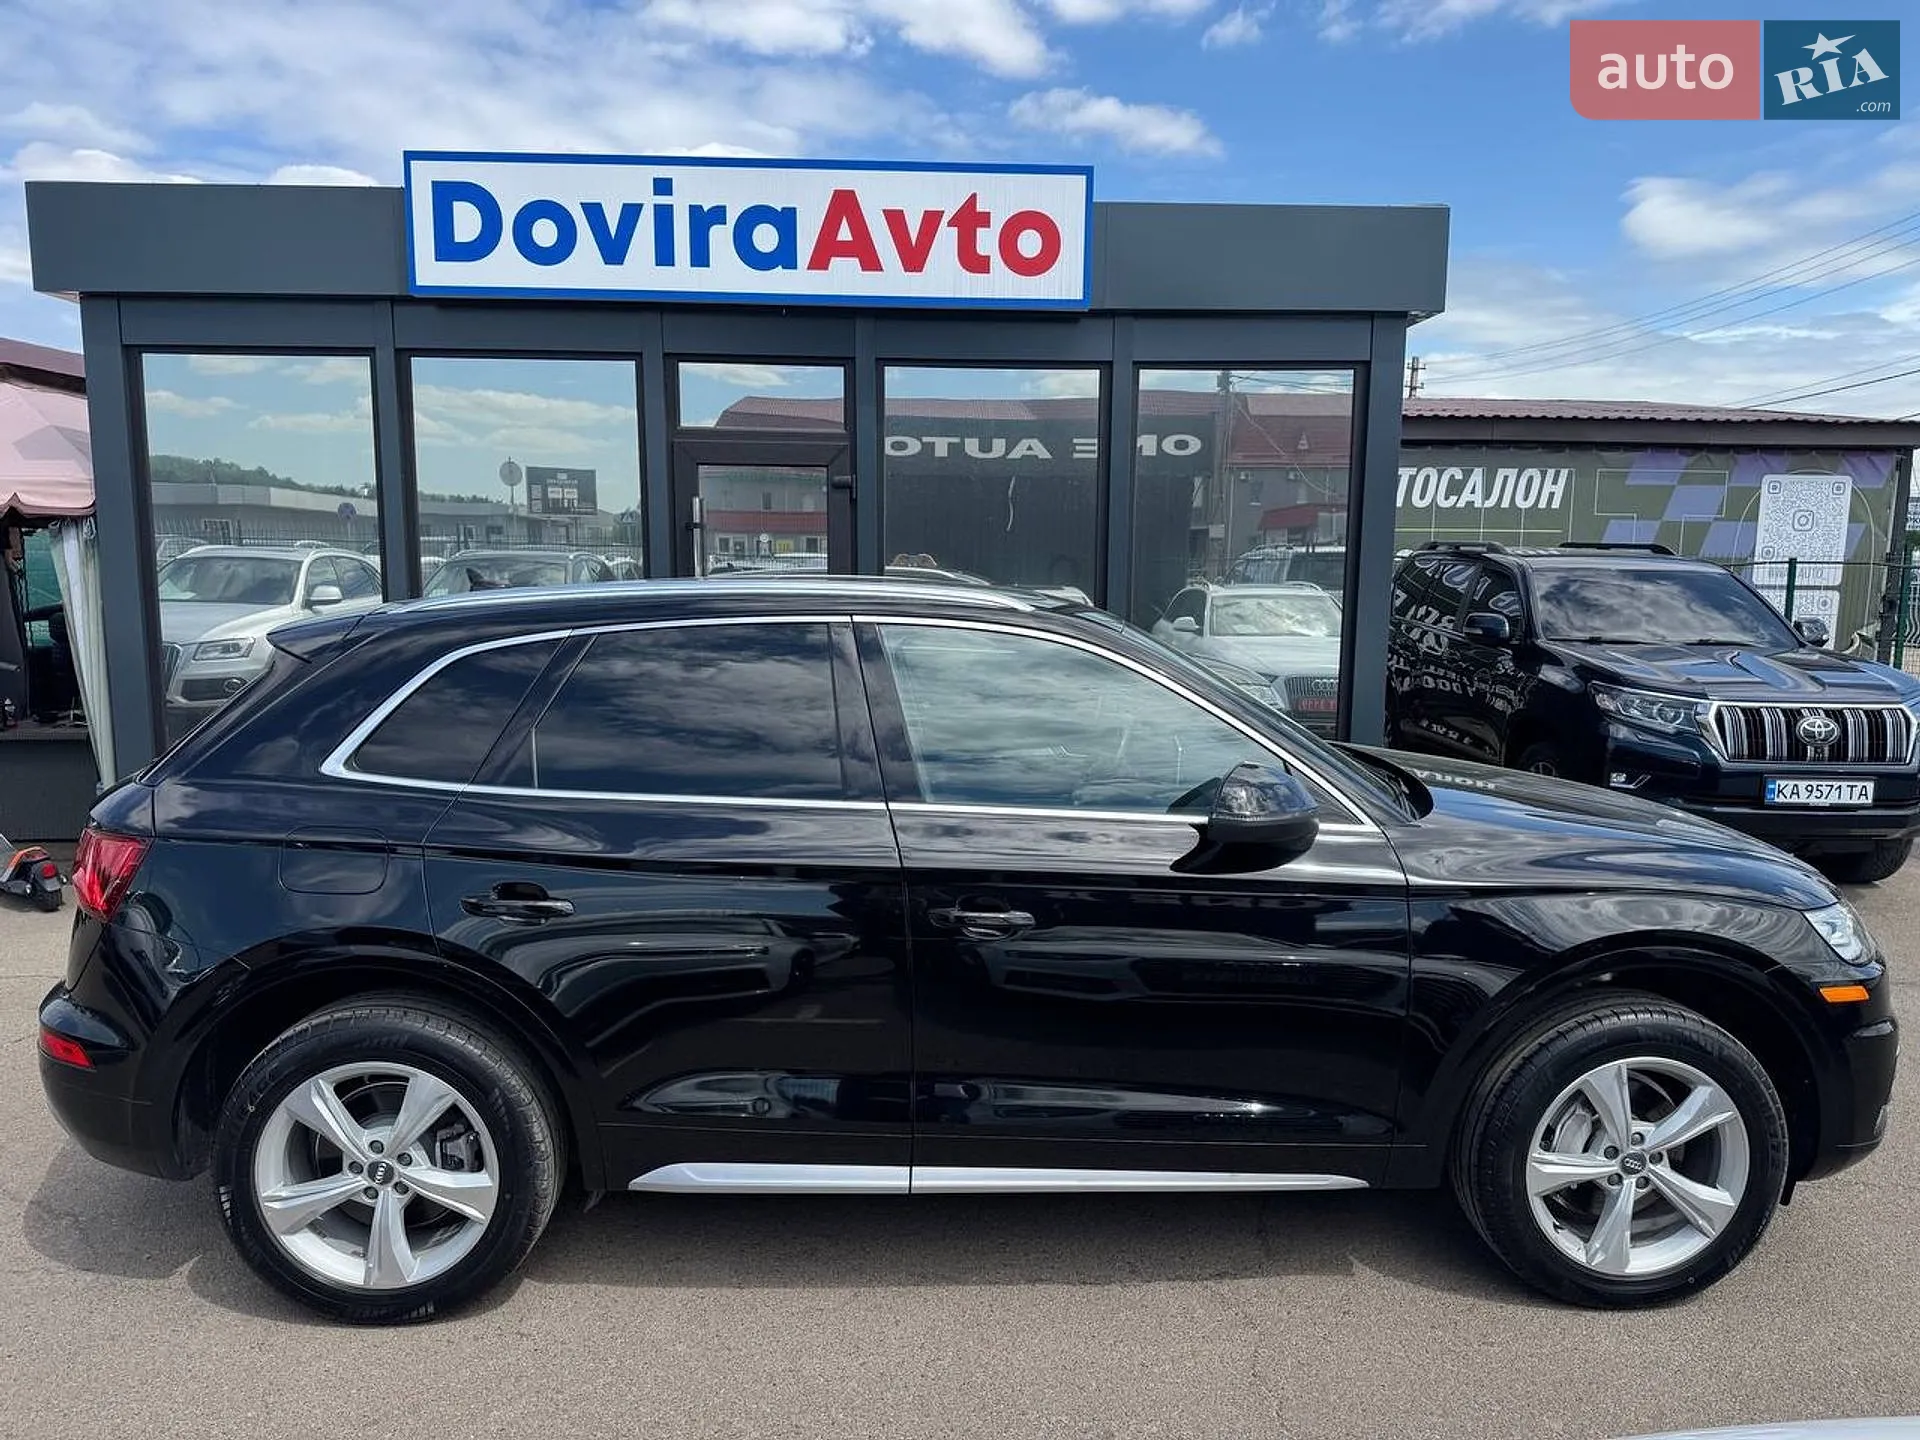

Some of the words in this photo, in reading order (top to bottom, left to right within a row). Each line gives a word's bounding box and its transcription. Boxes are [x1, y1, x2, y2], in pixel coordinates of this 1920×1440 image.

[431, 177, 1062, 277] DoviraAvto
[1776, 783, 1801, 800] KA
[1804, 784, 1842, 800] 9571
[1847, 785, 1869, 801] TA
